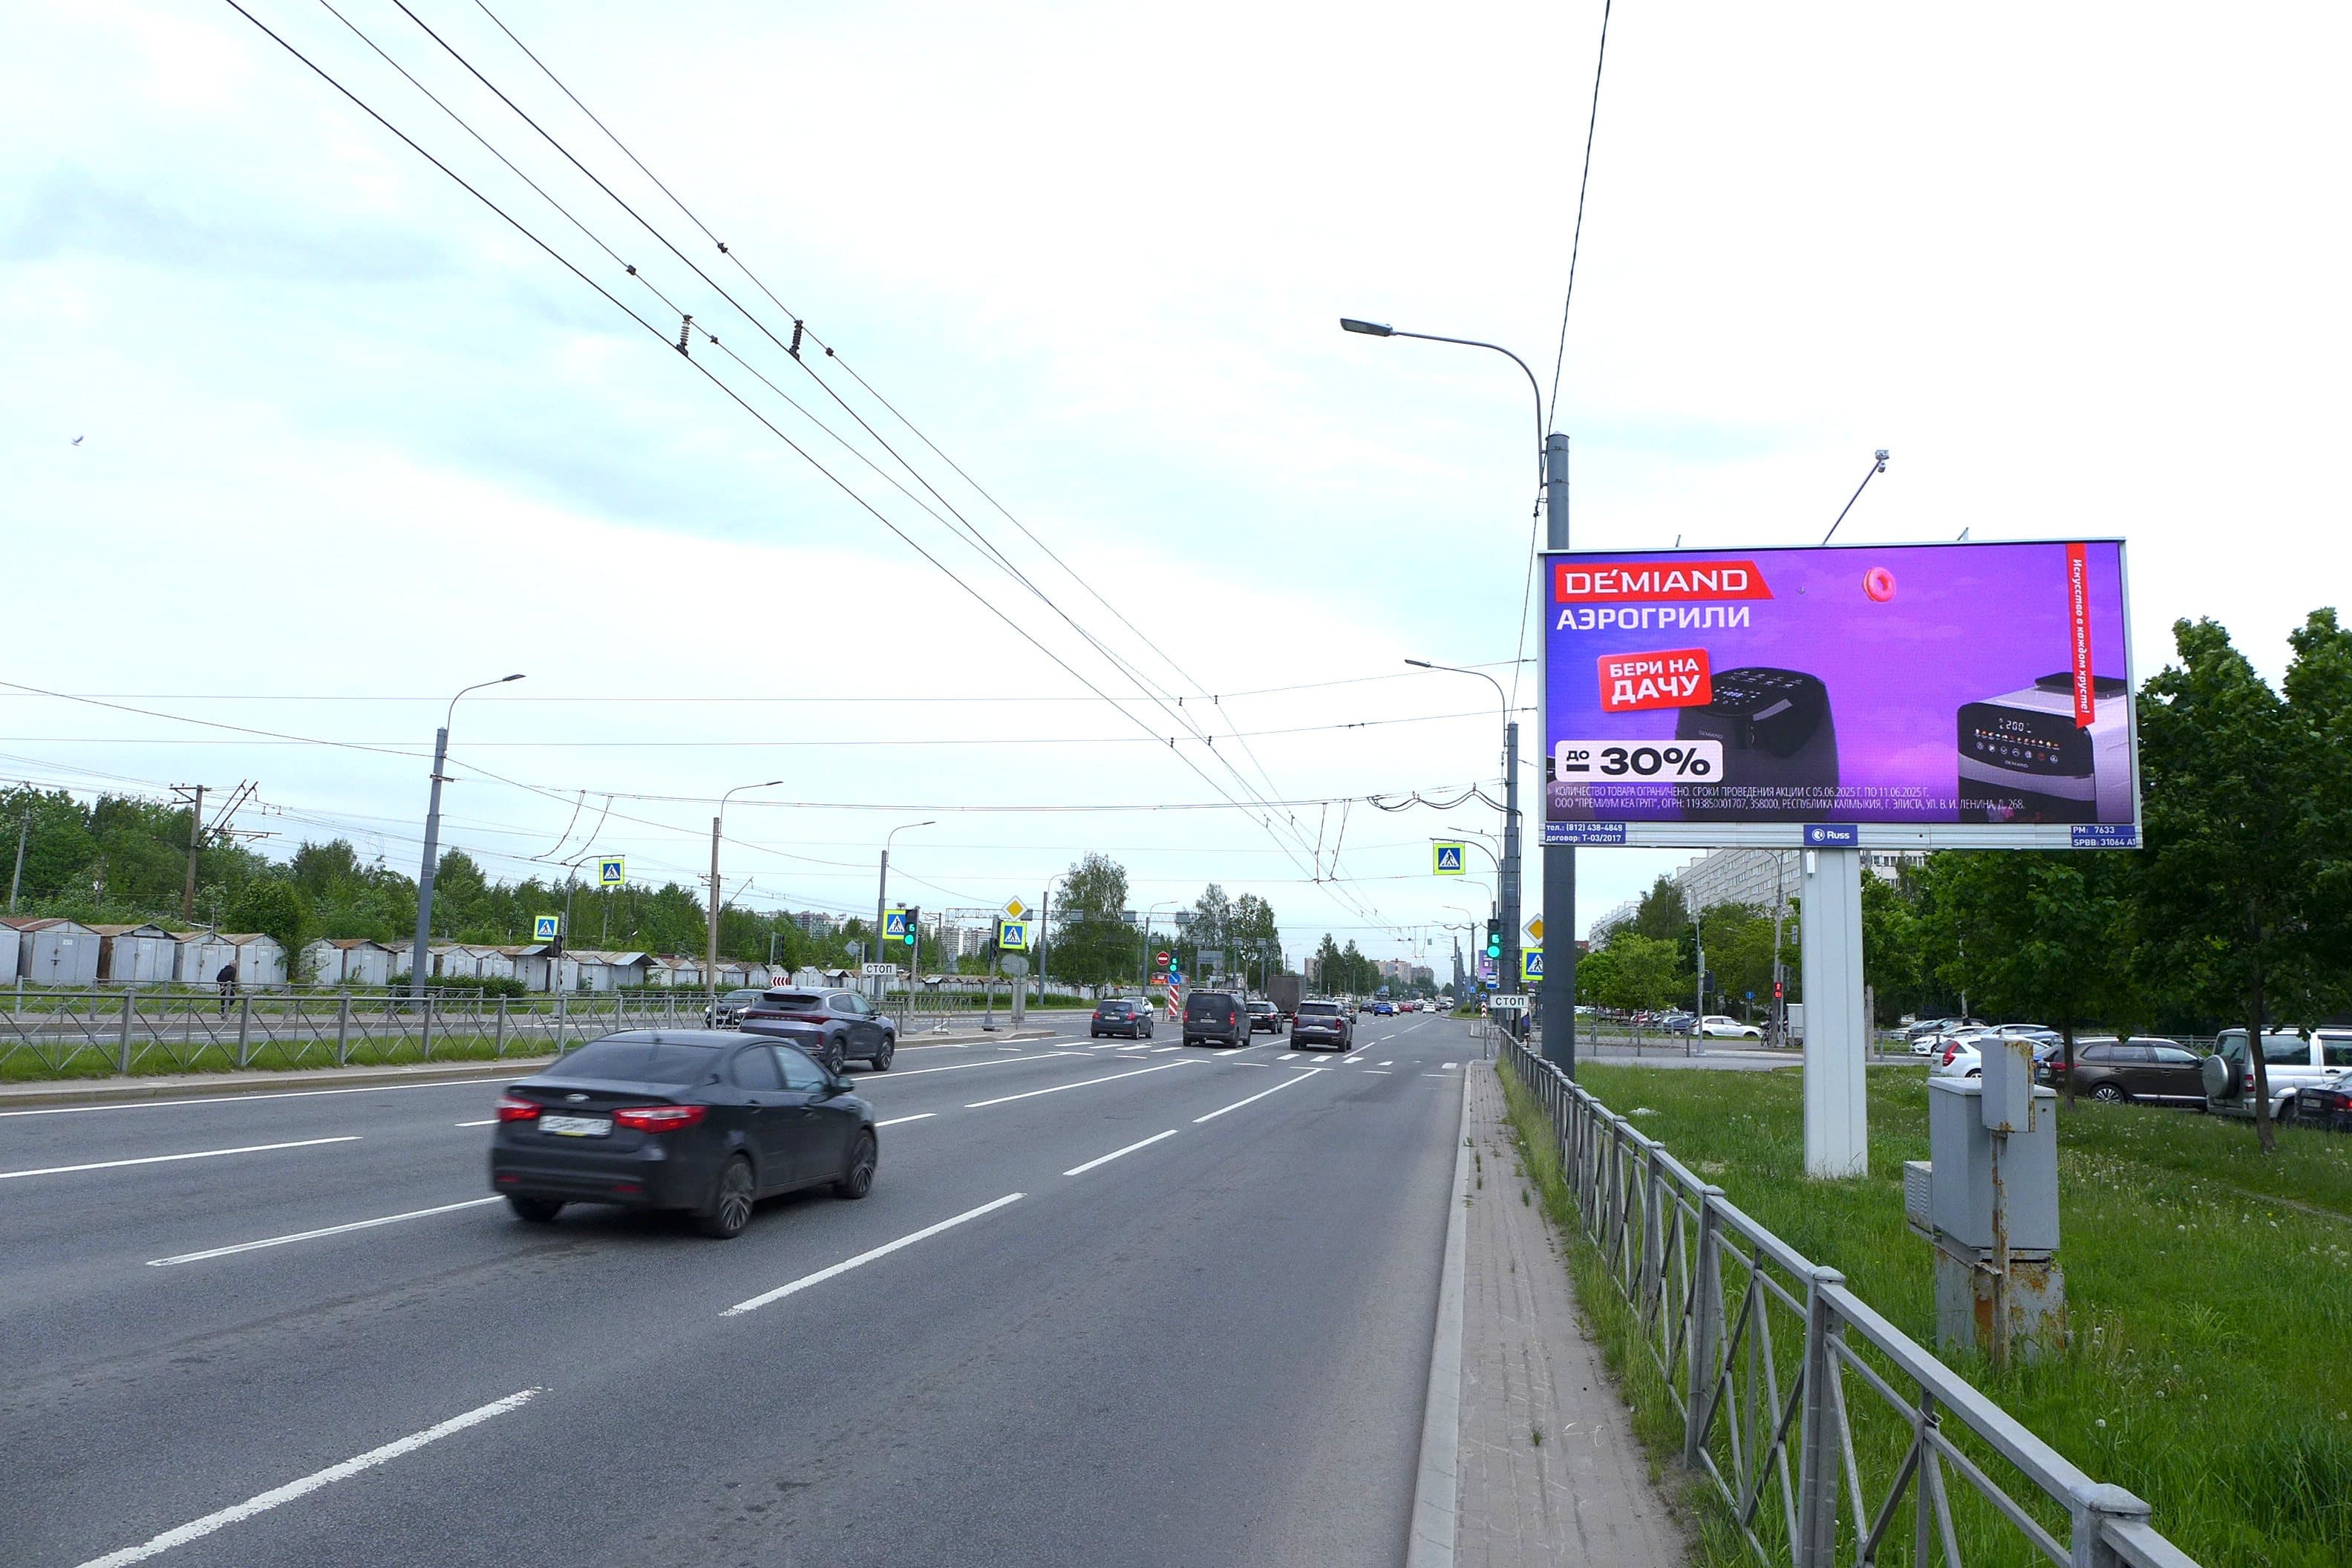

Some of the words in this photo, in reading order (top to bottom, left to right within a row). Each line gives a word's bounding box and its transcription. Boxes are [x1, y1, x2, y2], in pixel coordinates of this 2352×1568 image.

[1556, 606, 1750, 630] АЭРОГРИЛИ
[2076, 627, 2088, 668] каждом
[1609, 660, 1664, 678] БЕРИ
[1669, 658, 1700, 673] НА
[1611, 674, 1701, 705] ДАЧУ
[2077, 670, 2091, 713] хрусте!
[1566, 750, 1590, 762] до
[1555, 786, 1606, 797] КОЛИЧЕСТВО
[1607, 786, 1636, 797] ТОВАРА
[1636, 786, 1691, 797] ОГРАНИЧЕНО.
[1693, 786, 1719, 797] СРОКИ
[1721, 786, 1774, 798] ПРОВЕДЕНИЯ
[1775, 786, 1804, 798] АКЦИИ
[1812, 786, 1855, 797] 05.06.2025
[1864, 786, 1878, 797] ПО
[1879, 786, 1922, 797] 11.06.2025
[1555, 798, 1574, 808] ООО
[1662, 798, 1685, 808] ОГРН:
[1782, 798, 1833, 809] РЕСПУБЛИКА
[1892, 799, 1925, 810] ЭЛИСТА,
[1566, 823, 1586, 832] (812)
[2094, 826, 2115, 834] 7633
[1546, 835, 1581, 843] договор:
[1581, 834, 1621, 843] Т-03/2017
[1826, 830, 1850, 840] Russ
[2100, 837, 2125, 846] 31064
[2126, 837, 2136, 846] A1
[866, 964, 892, 973] СТОП
[1495, 997, 1524, 1006] СТОП
